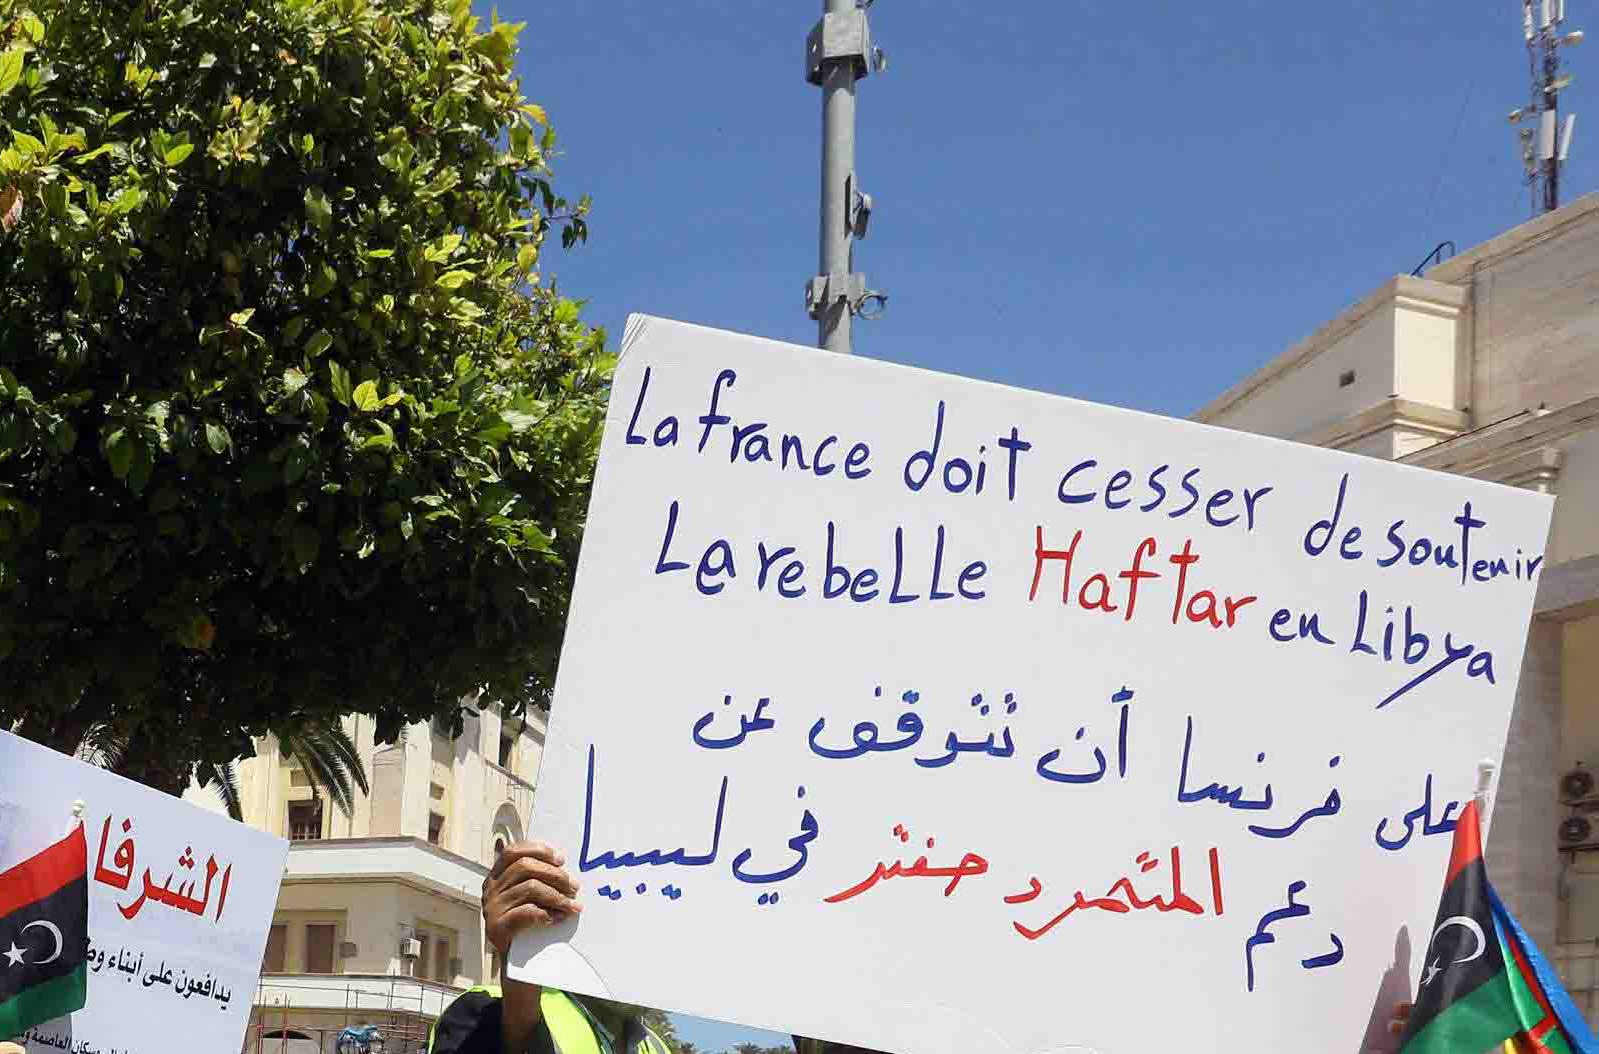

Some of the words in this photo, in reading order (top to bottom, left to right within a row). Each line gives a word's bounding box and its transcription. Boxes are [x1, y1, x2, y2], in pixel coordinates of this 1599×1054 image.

[625, 365, 679, 447] La
[903, 399, 1033, 502] doit
[1057, 459, 1274, 534] cesser
[1303, 472, 1364, 560] de
[1376, 501, 1544, 586] soutenir
[1029, 524, 1258, 630] Haftar
[1268, 607, 1335, 646] en
[1350, 589, 1497, 710] Libya
[692, 694, 777, 751] عن
[807, 685, 1019, 769] تتوقف
[1035, 685, 1136, 784] أن
[578, 742, 729, 901] ليبيا
[1177, 714, 1343, 839] فرنسا
[1374, 773, 1460, 851] على
[731, 785, 820, 907] في
[821, 823, 990, 904] حفتر
[1003, 846, 1225, 940] المتمرد
[107, 945, 144, 983] أبناء
[142, 960, 173, 987] على
[1245, 879, 1345, 993] دعم
[174, 969, 232, 1011] يدافعون
